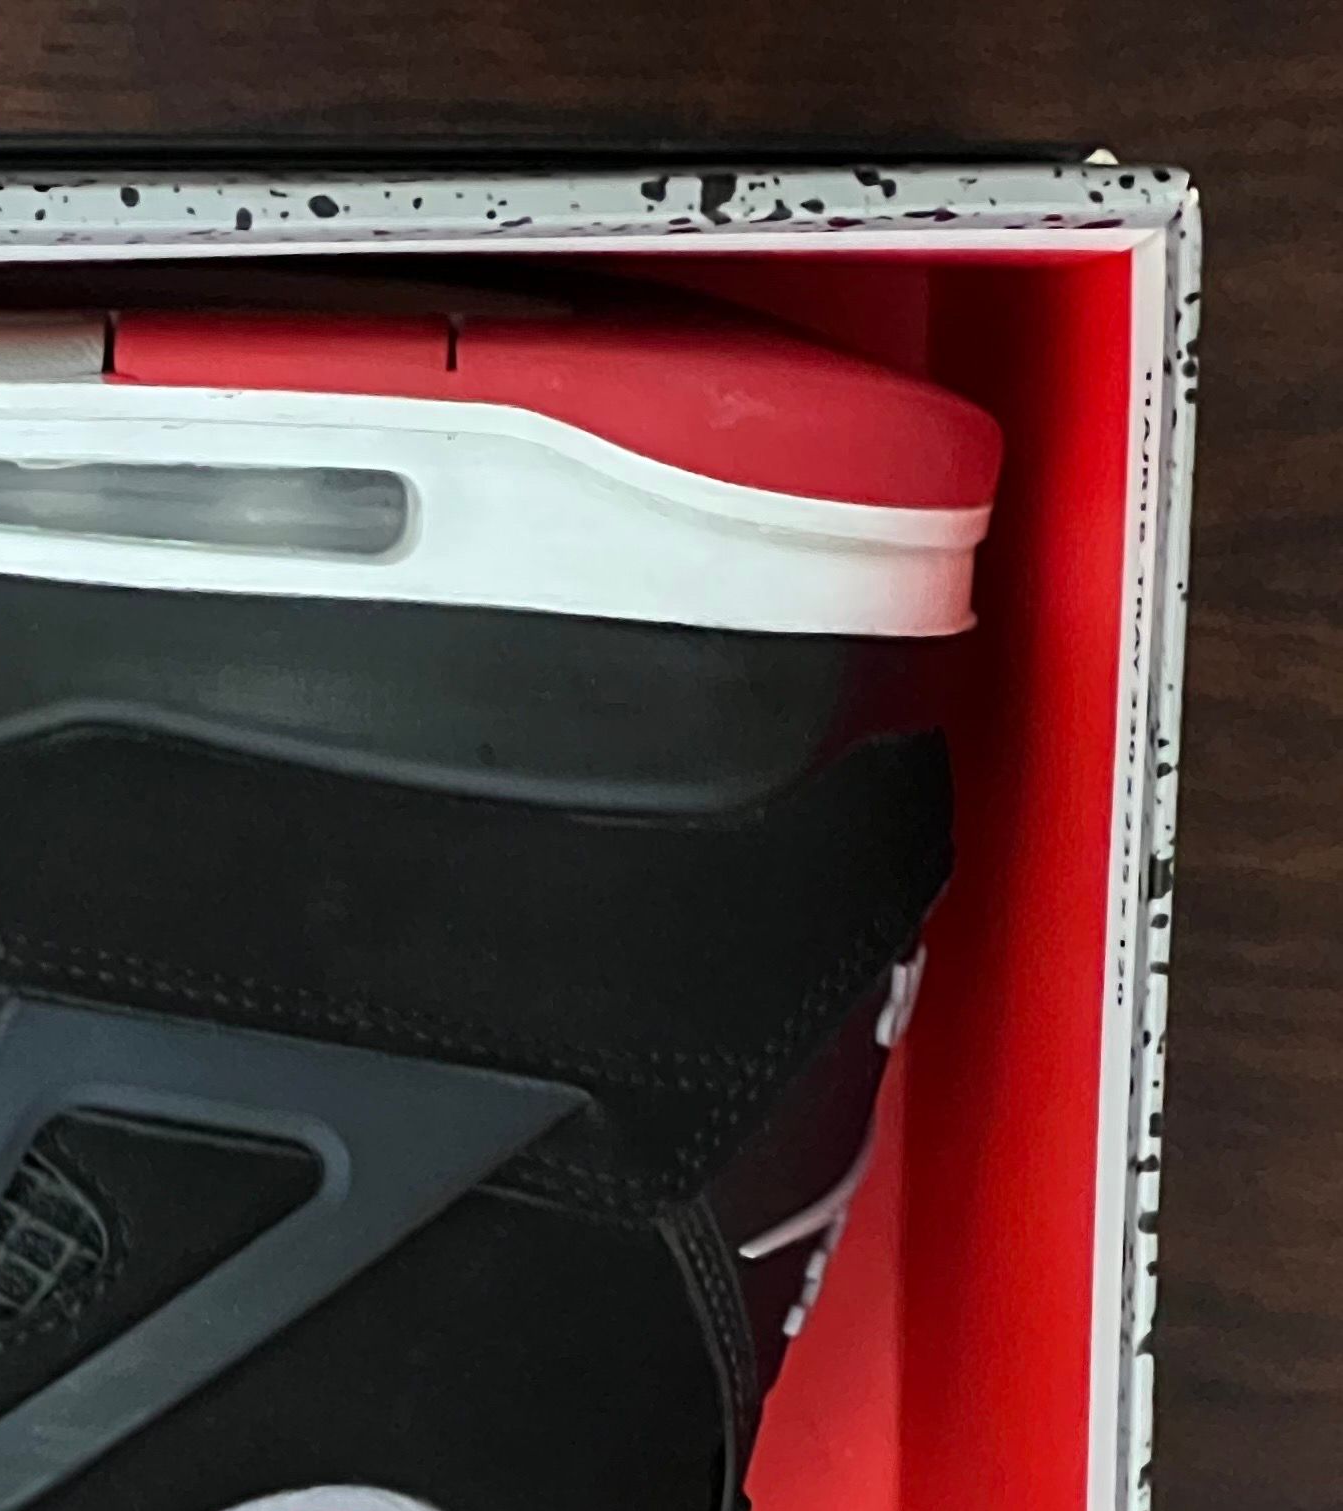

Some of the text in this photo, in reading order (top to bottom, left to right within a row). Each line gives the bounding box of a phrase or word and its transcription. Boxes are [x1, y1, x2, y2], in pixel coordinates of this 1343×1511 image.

[1132, 571, 1145, 676] TRAY
[1128, 690, 1138, 766] 330
[1116, 935, 1127, 1007] 120
